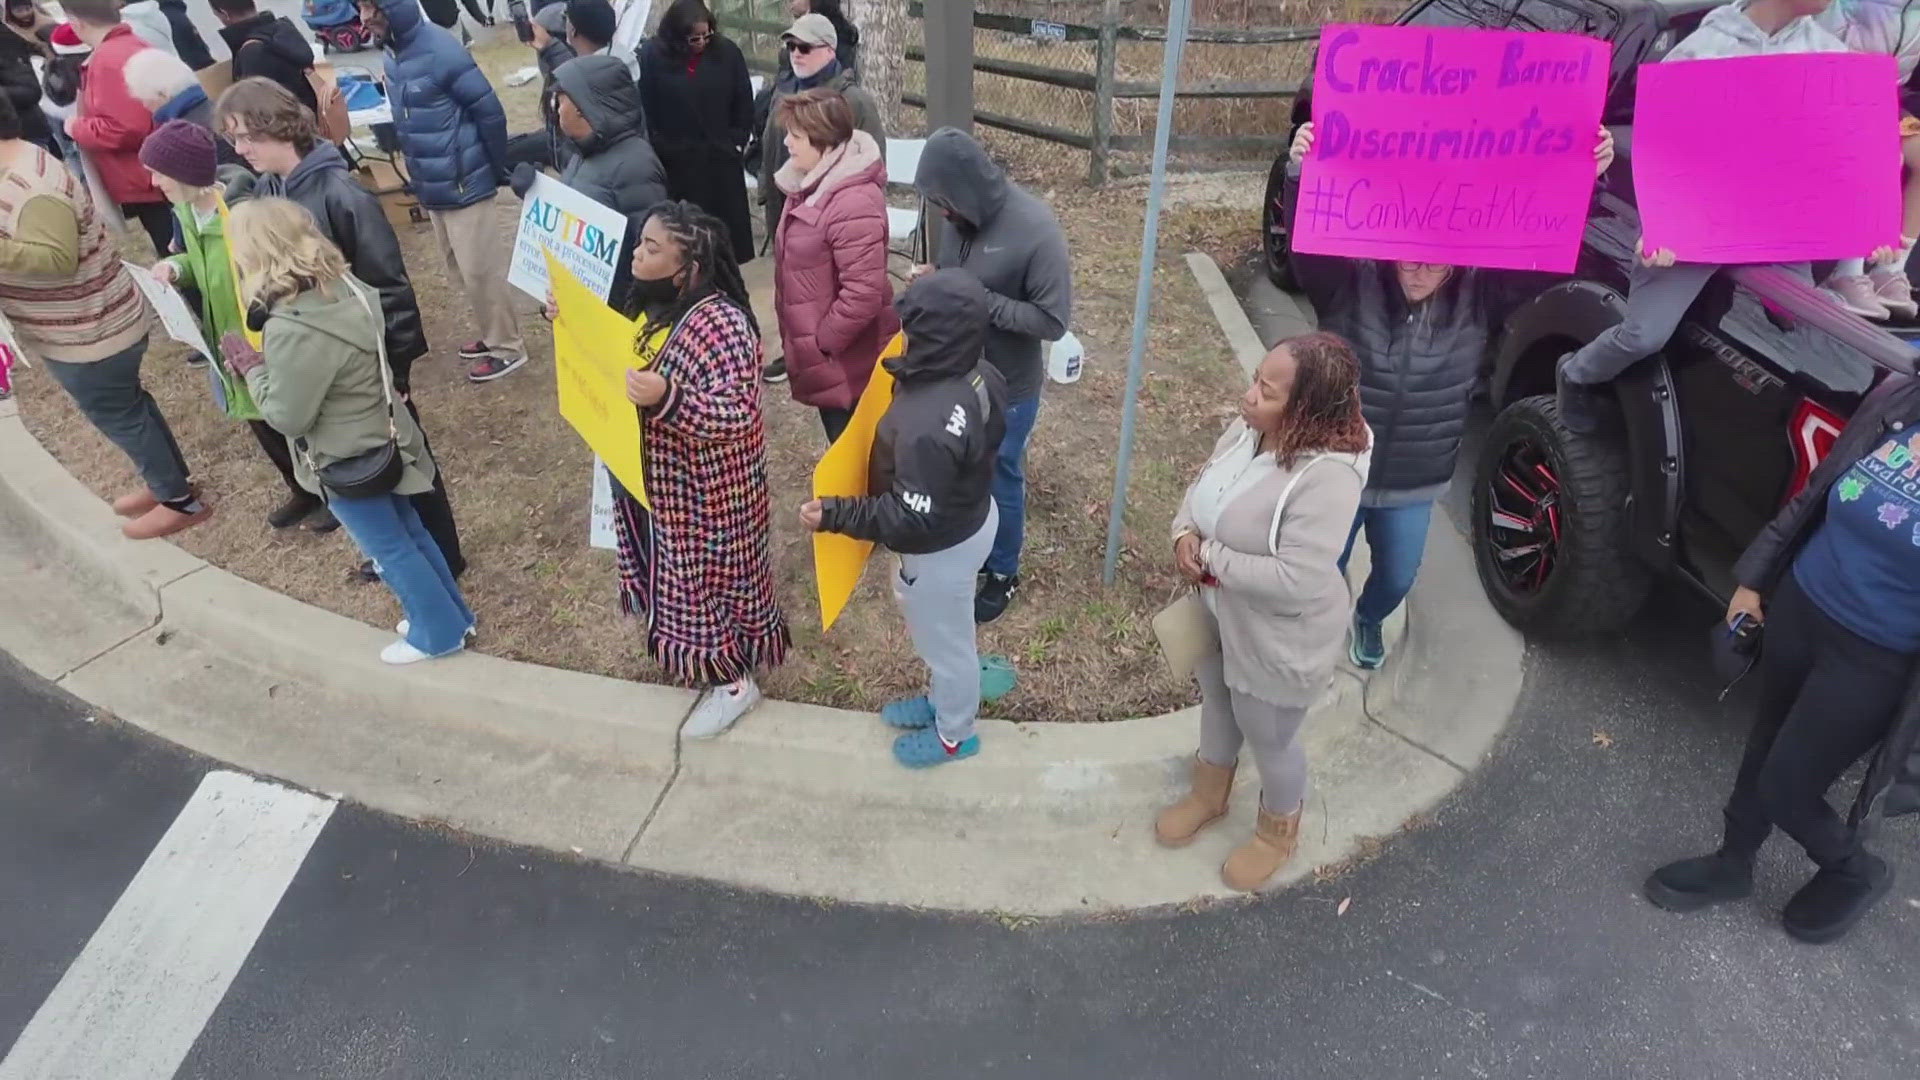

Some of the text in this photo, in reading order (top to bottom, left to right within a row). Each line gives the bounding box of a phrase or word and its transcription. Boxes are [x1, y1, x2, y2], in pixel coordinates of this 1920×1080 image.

[1324, 32, 1593, 96] Cracker Barrel
[1317, 105, 1576, 162] Discriminates
[526, 197, 619, 268] AUTISM
[1304, 176, 1569, 233] #CanWeEatNow
[1689, 323, 1787, 389] PORT
